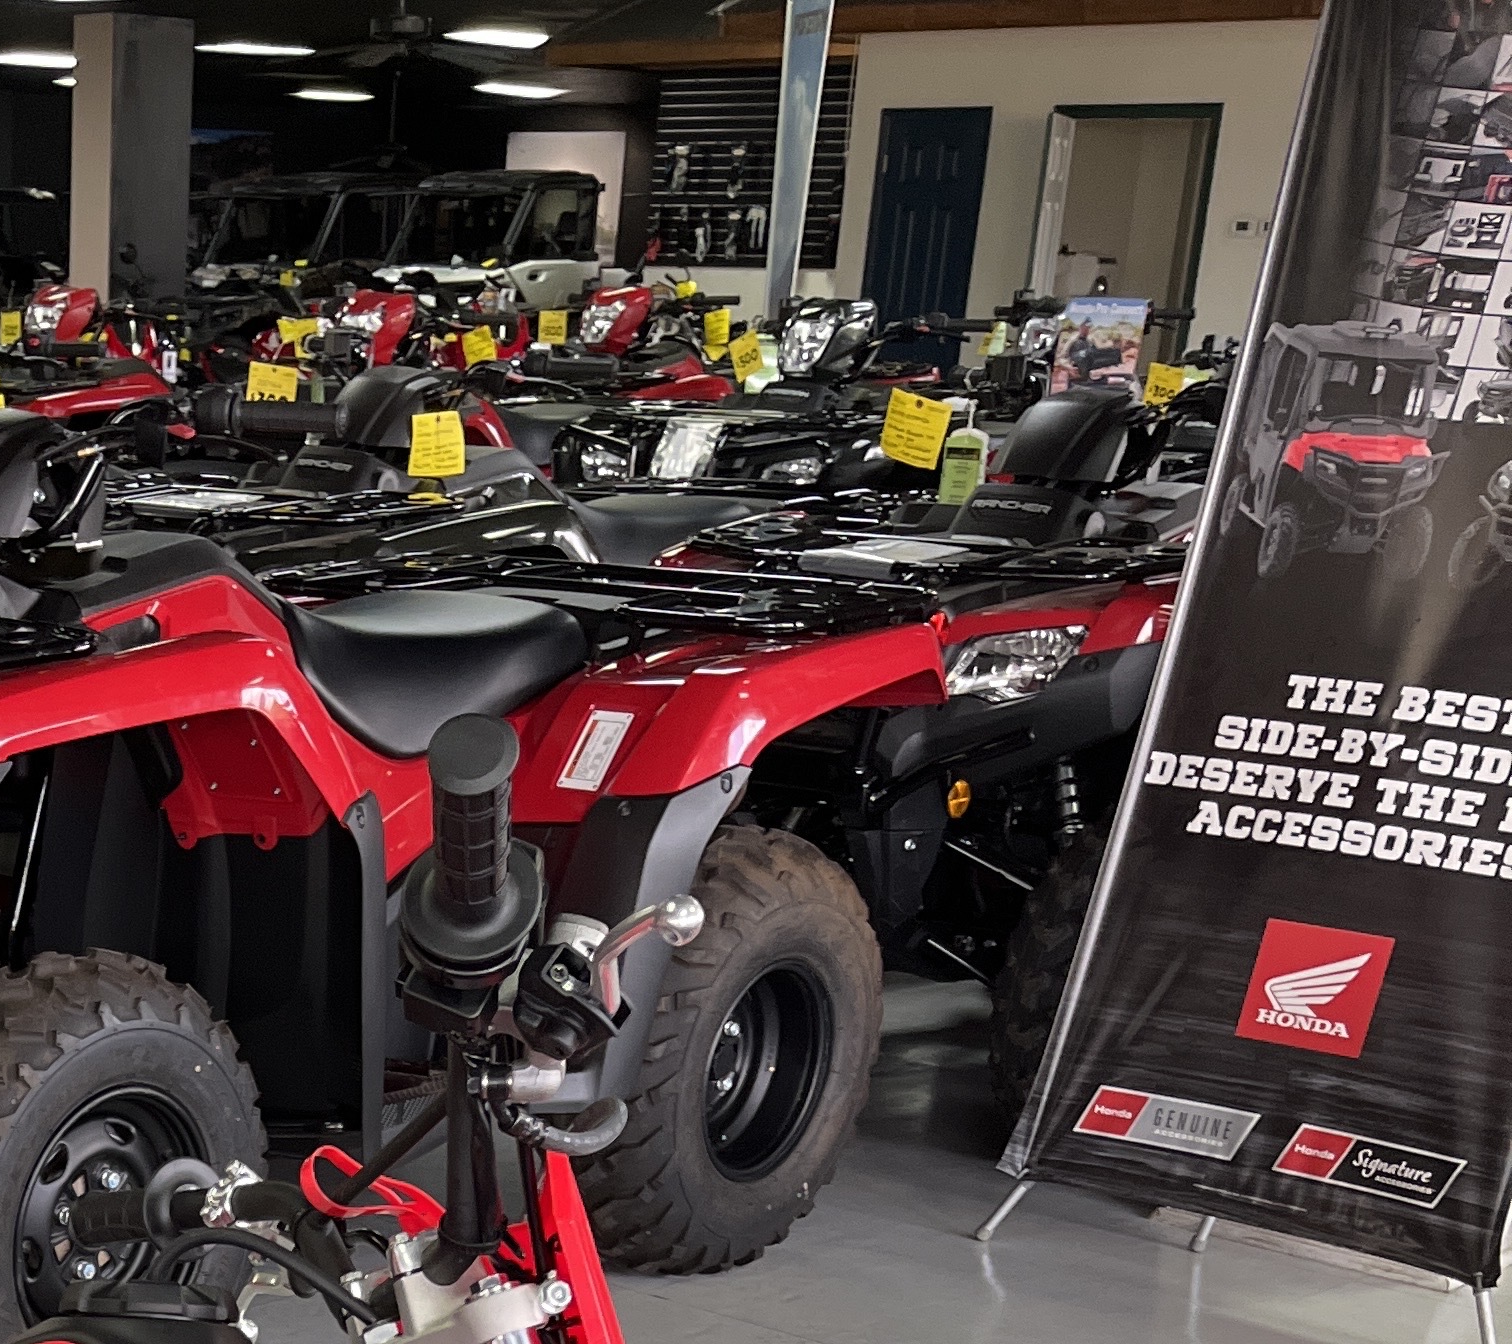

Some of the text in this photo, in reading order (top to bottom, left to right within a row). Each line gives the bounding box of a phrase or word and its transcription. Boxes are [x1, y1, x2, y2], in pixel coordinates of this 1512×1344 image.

[1287, 674, 1384, 717] THE
[1214, 714, 1512, 787] SIDE-BY-SID
[1144, 751, 1360, 809] DESERVE
[1376, 778, 1487, 828] THE
[1255, 1008, 1350, 1039] HONDA
[1093, 1103, 1233, 1140] Honda GENUINE
[1294, 1143, 1433, 1184] Honda Signature
